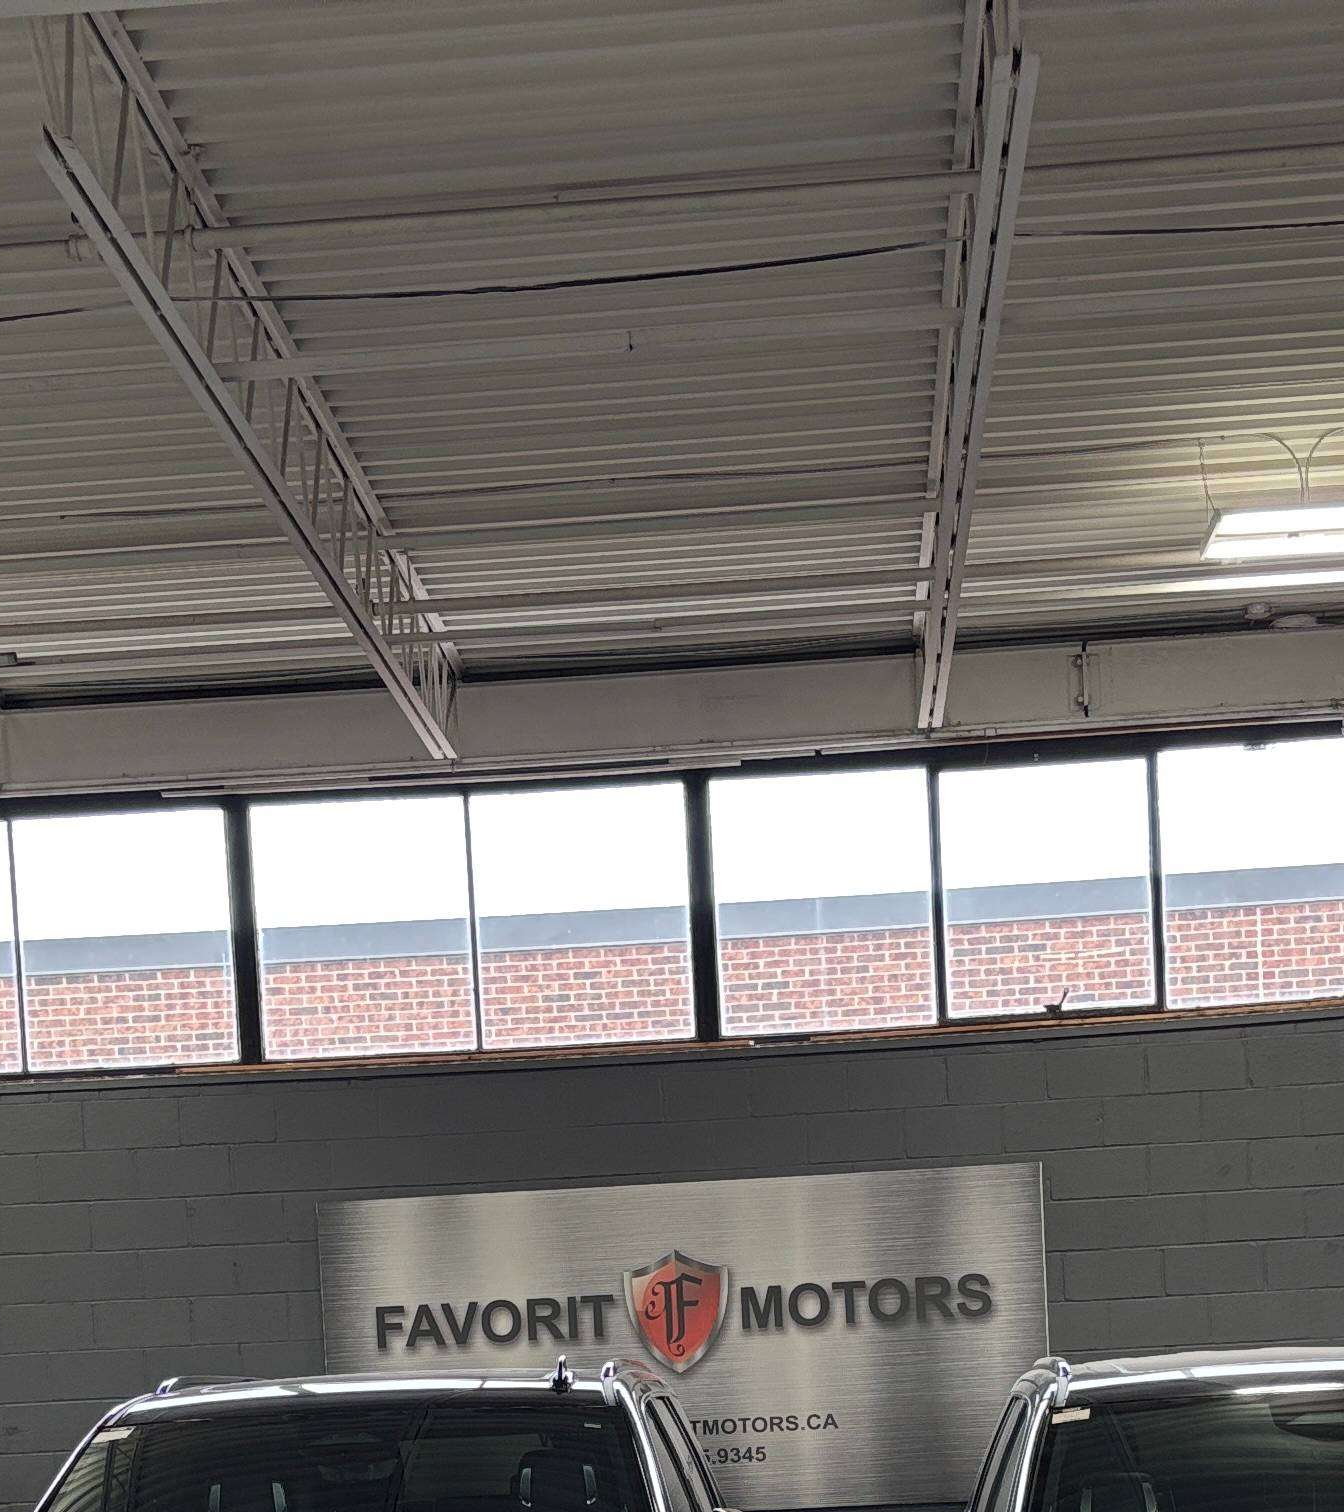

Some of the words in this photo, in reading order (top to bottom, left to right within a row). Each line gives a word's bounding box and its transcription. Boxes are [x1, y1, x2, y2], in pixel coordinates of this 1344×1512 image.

[375, 1294, 614, 1350] FAVORIT
[740, 1273, 993, 1331] MOTORS
[690, 1413, 839, 1435] TMOTORS.CA
